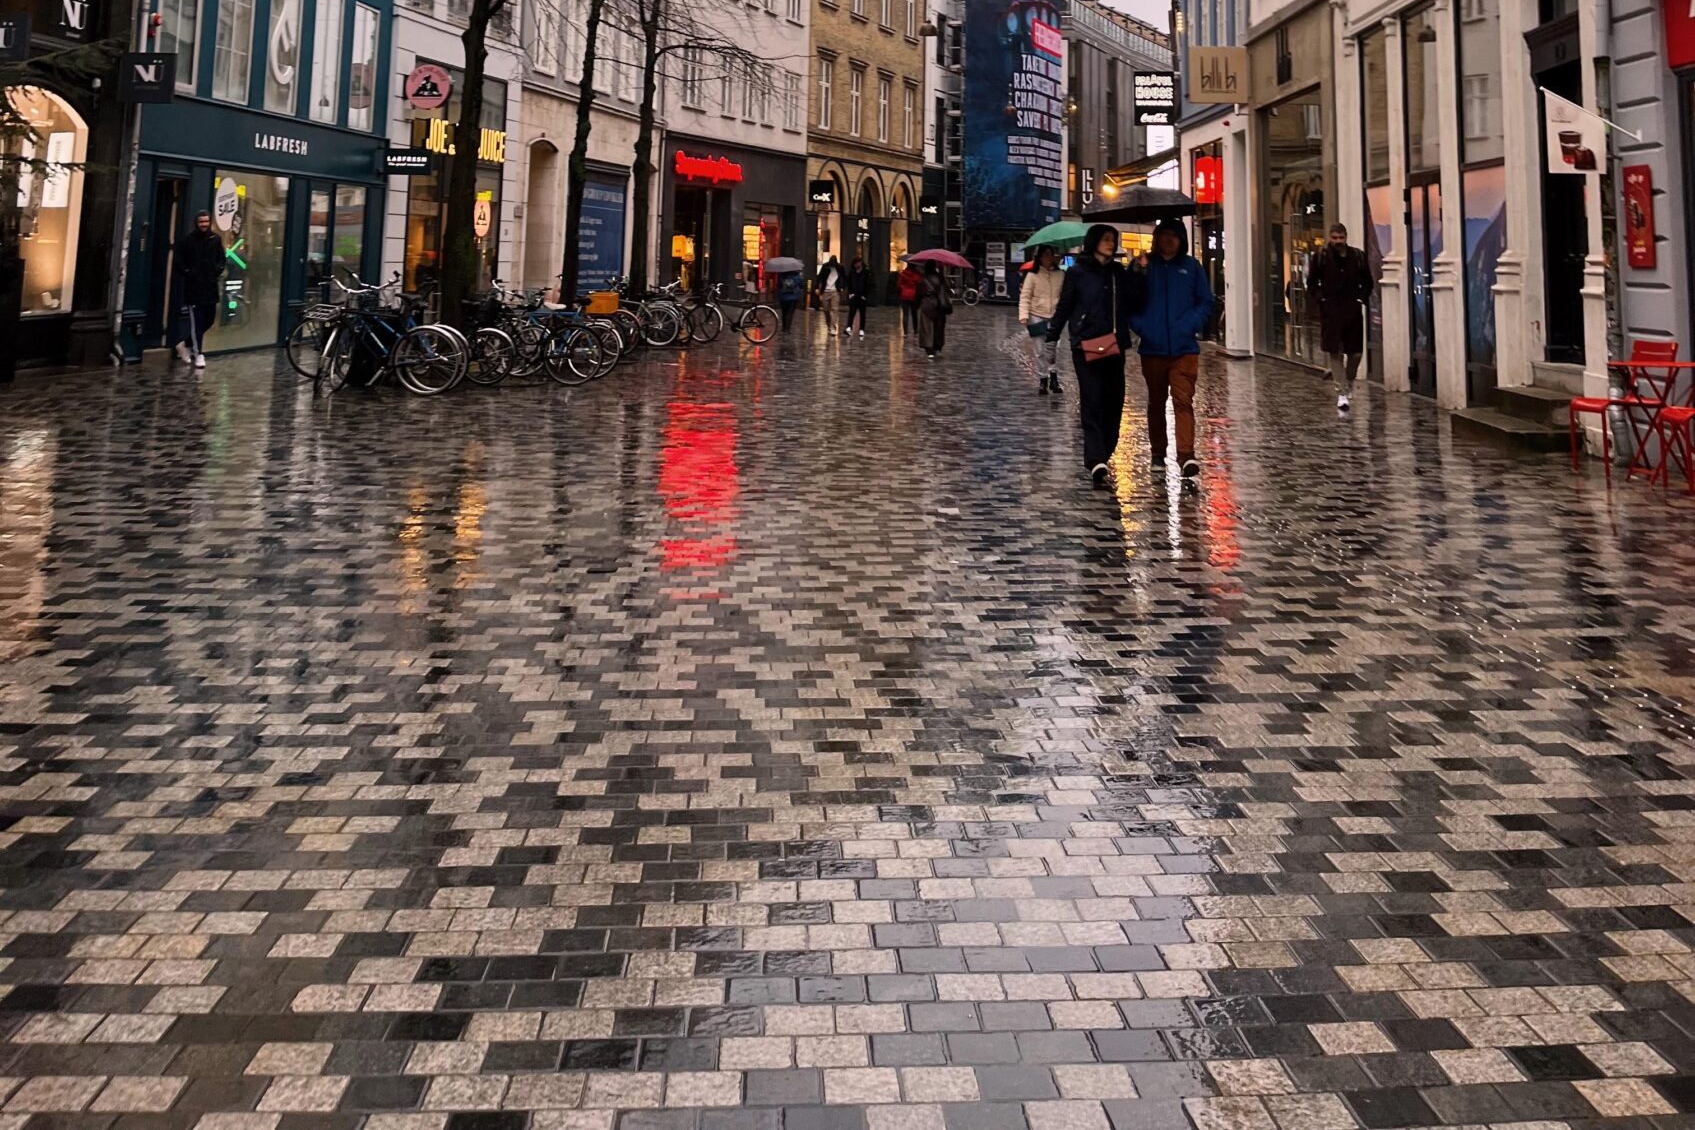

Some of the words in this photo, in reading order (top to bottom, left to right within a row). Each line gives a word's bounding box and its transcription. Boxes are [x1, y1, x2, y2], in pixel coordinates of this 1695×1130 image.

[0, 21, 16, 49] Ü
[133, 59, 164, 83] NÜ
[1200, 56, 1222, 90] billi
[1224, 56, 1237, 90] bi
[1135, 86, 1173, 99] HOUSE
[255, 133, 308, 156] LABFRESH
[426, 118, 449, 154] JOE
[448, 143, 456, 155] &
[478, 127, 507, 163] JUICE
[387, 155, 428, 163] LABFRESH
[1081, 169, 1093, 210] ILLU
[218, 199, 235, 217] SALE
